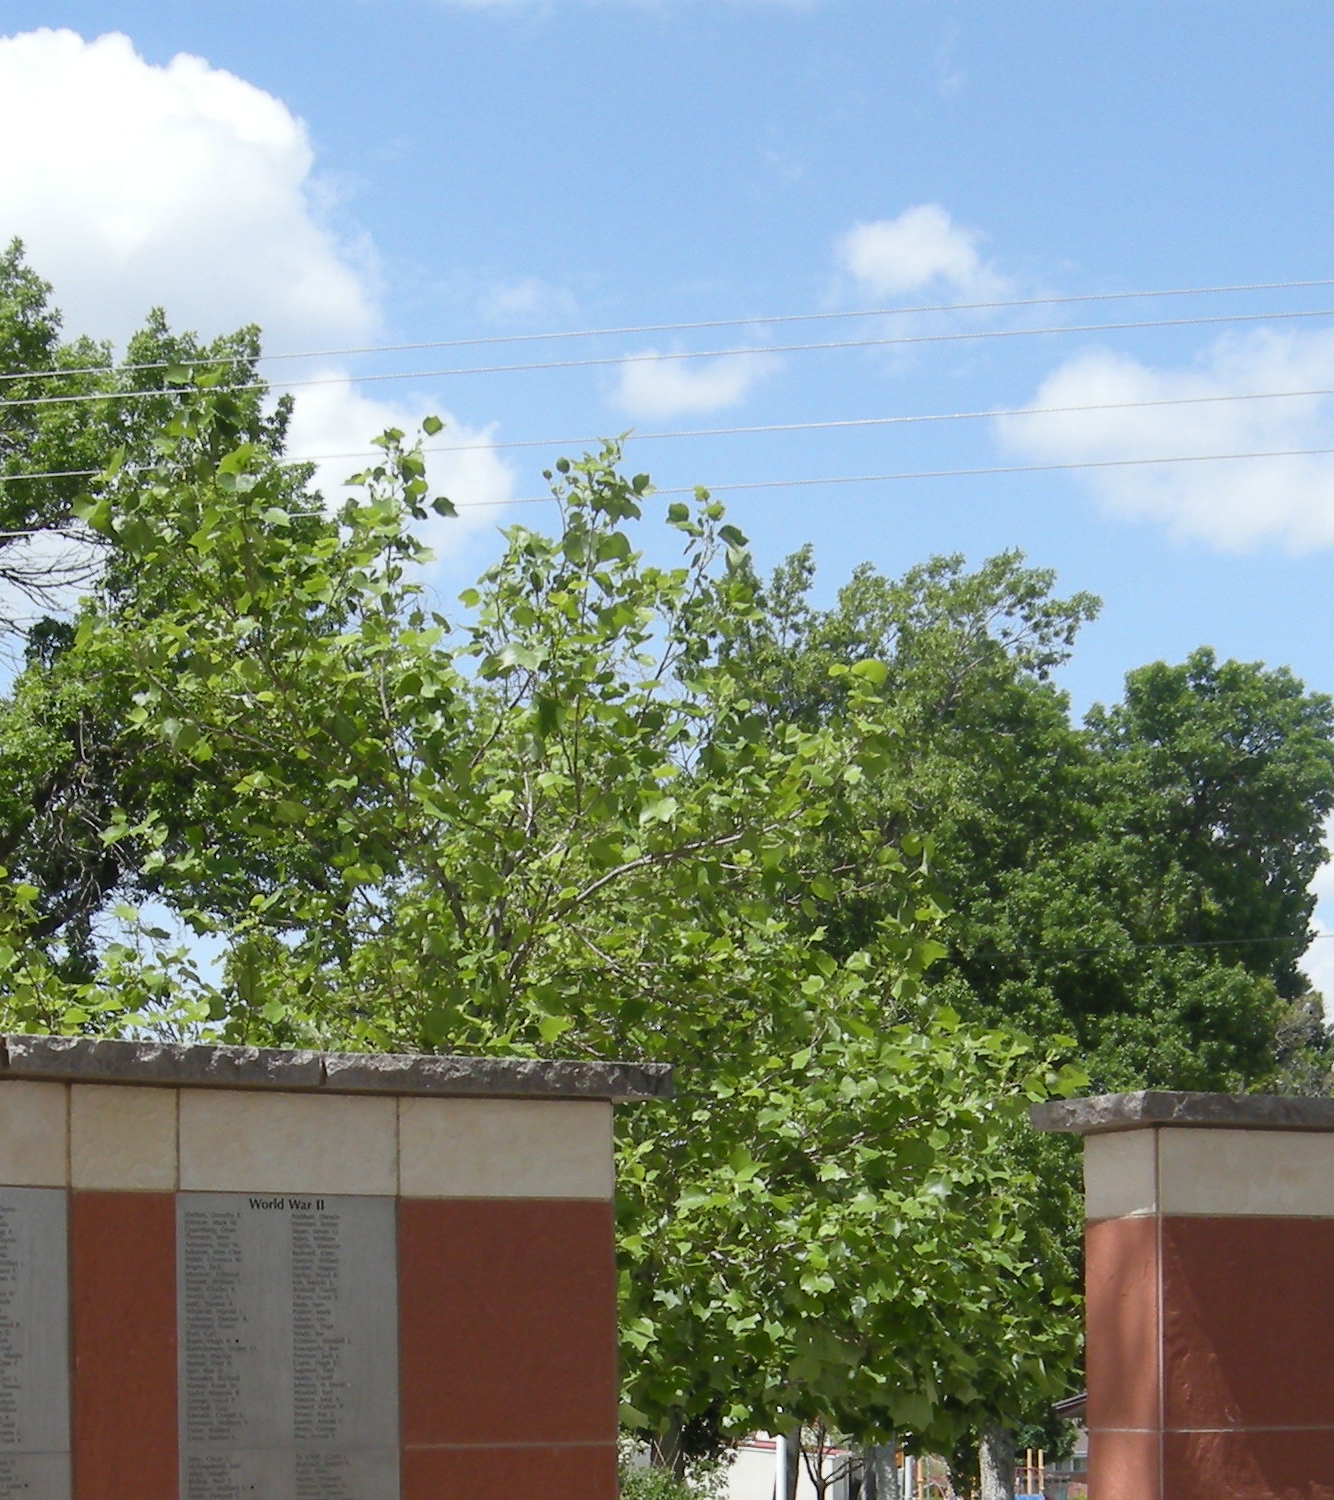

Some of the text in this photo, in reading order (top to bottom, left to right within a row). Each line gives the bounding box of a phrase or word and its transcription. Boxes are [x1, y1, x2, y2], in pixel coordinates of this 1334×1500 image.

[249, 1198, 325, 1211] World War II
